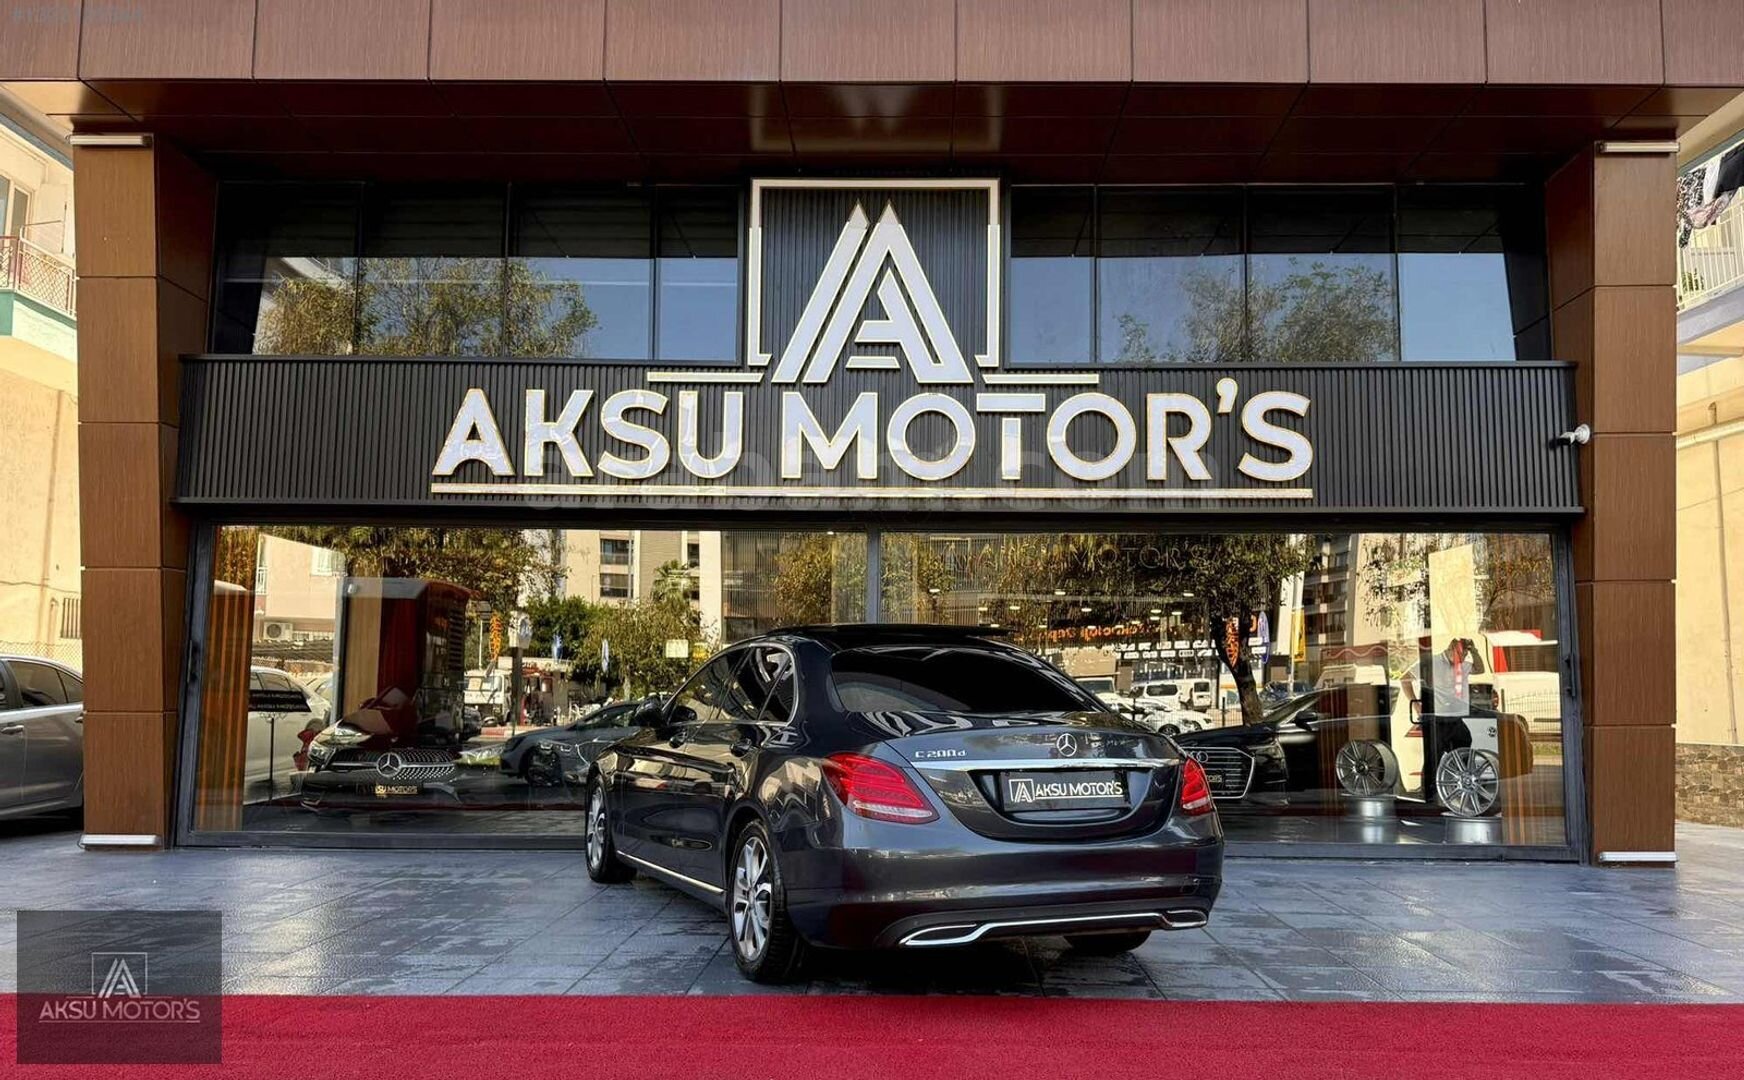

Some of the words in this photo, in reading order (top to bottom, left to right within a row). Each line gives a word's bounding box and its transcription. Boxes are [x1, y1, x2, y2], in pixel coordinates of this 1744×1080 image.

[433, 387, 746, 479] AKSU
[780, 377, 1315, 483] MOTOR'S
[1035, 781, 1068, 797] AKSU
[1069, 780, 1123, 796] MOTOR'S
